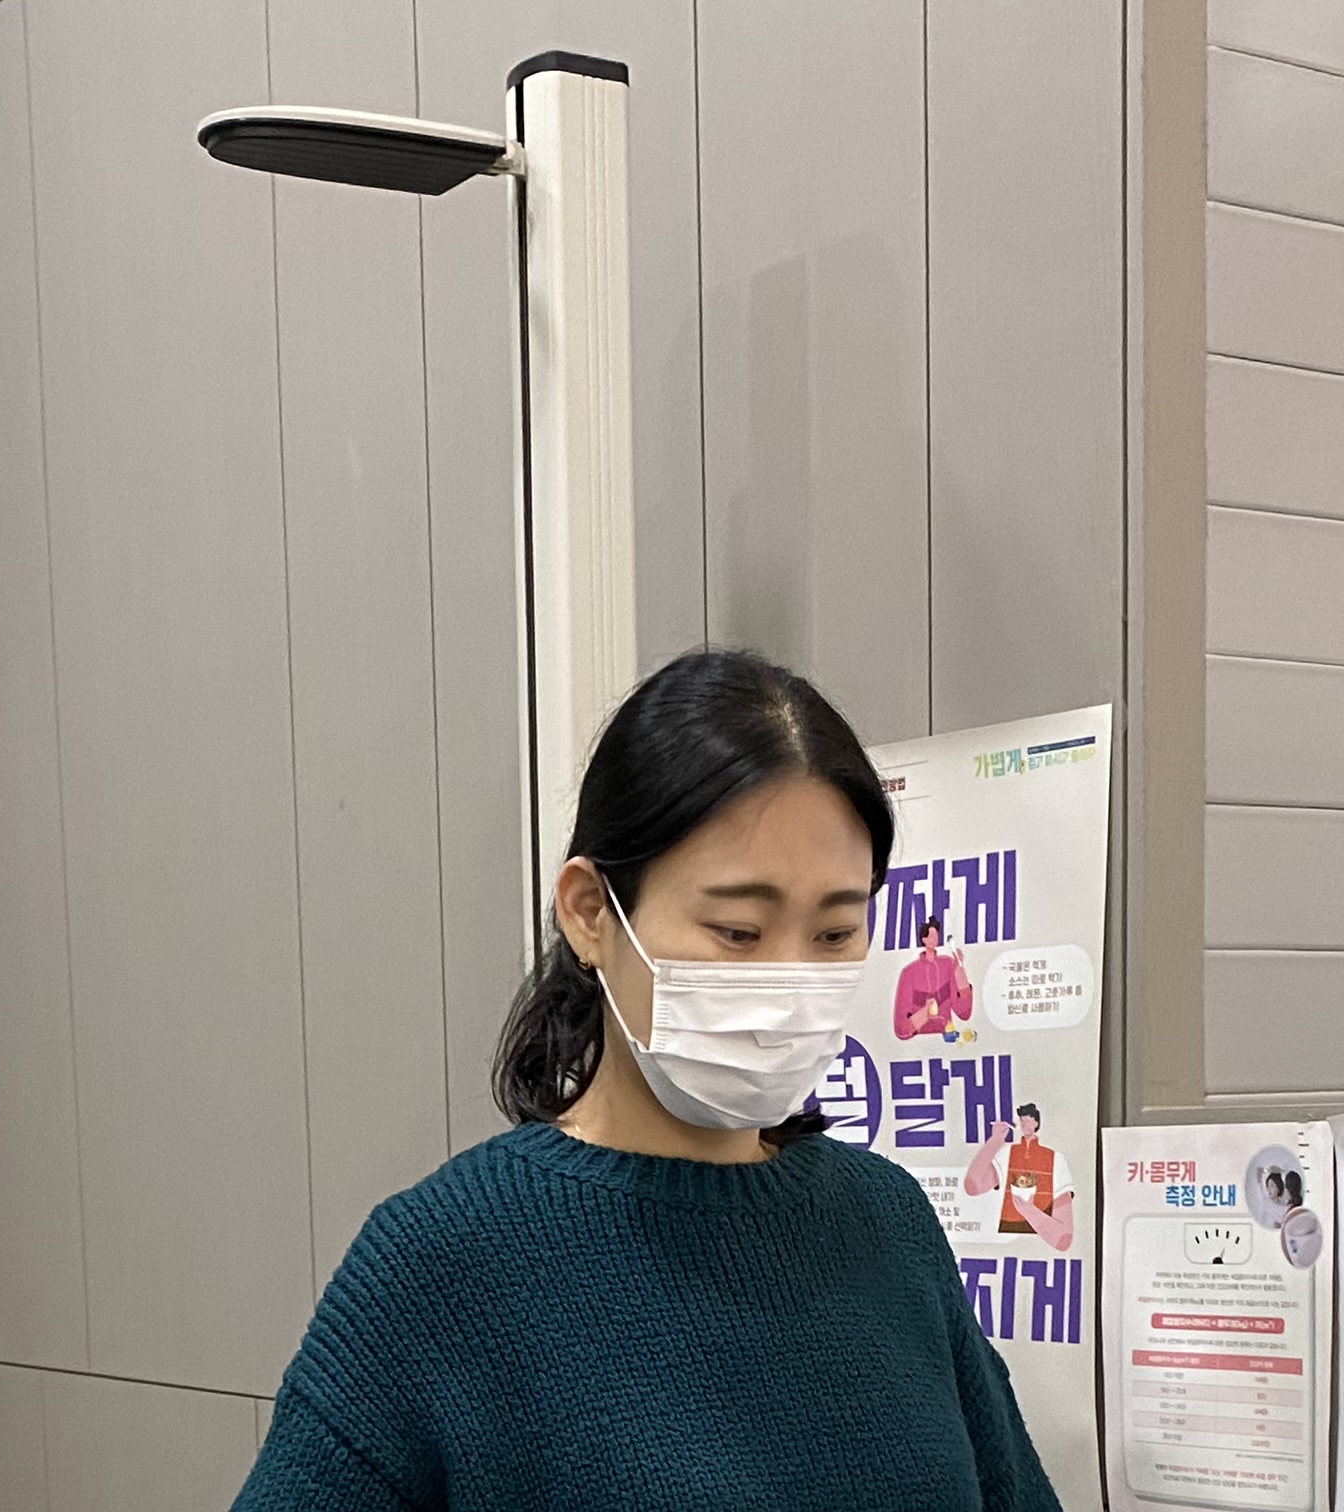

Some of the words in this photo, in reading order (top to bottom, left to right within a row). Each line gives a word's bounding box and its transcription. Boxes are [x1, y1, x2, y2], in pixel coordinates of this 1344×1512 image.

[890, 1055, 1014, 1148] 달게
[1165, 1184, 1196, 1207] 측정
[1201, 1184, 1236, 1207] 안내
